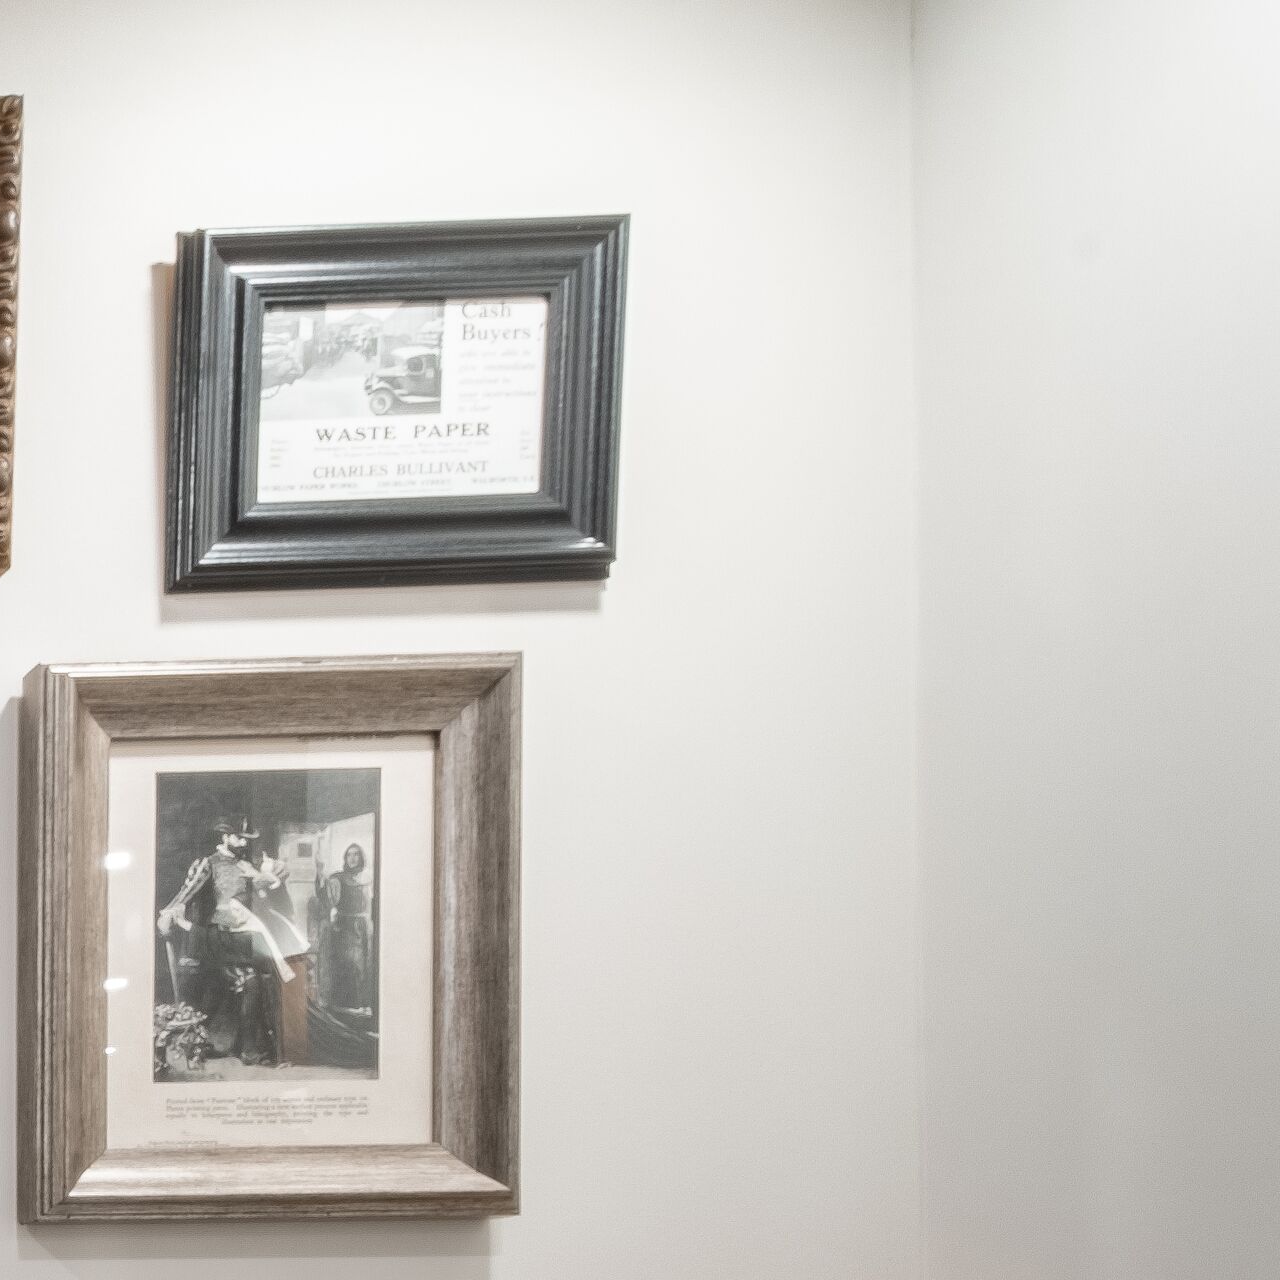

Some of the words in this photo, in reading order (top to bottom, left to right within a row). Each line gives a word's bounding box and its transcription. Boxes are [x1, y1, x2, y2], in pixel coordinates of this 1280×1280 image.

[461, 300, 511, 319] Cash
[462, 323, 531, 344] Buyers
[315, 425, 398, 443] WASTE
[413, 421, 491, 440] PAPER
[312, 463, 389, 480] CHARLES
[396, 459, 490, 477] BULLIVANT
